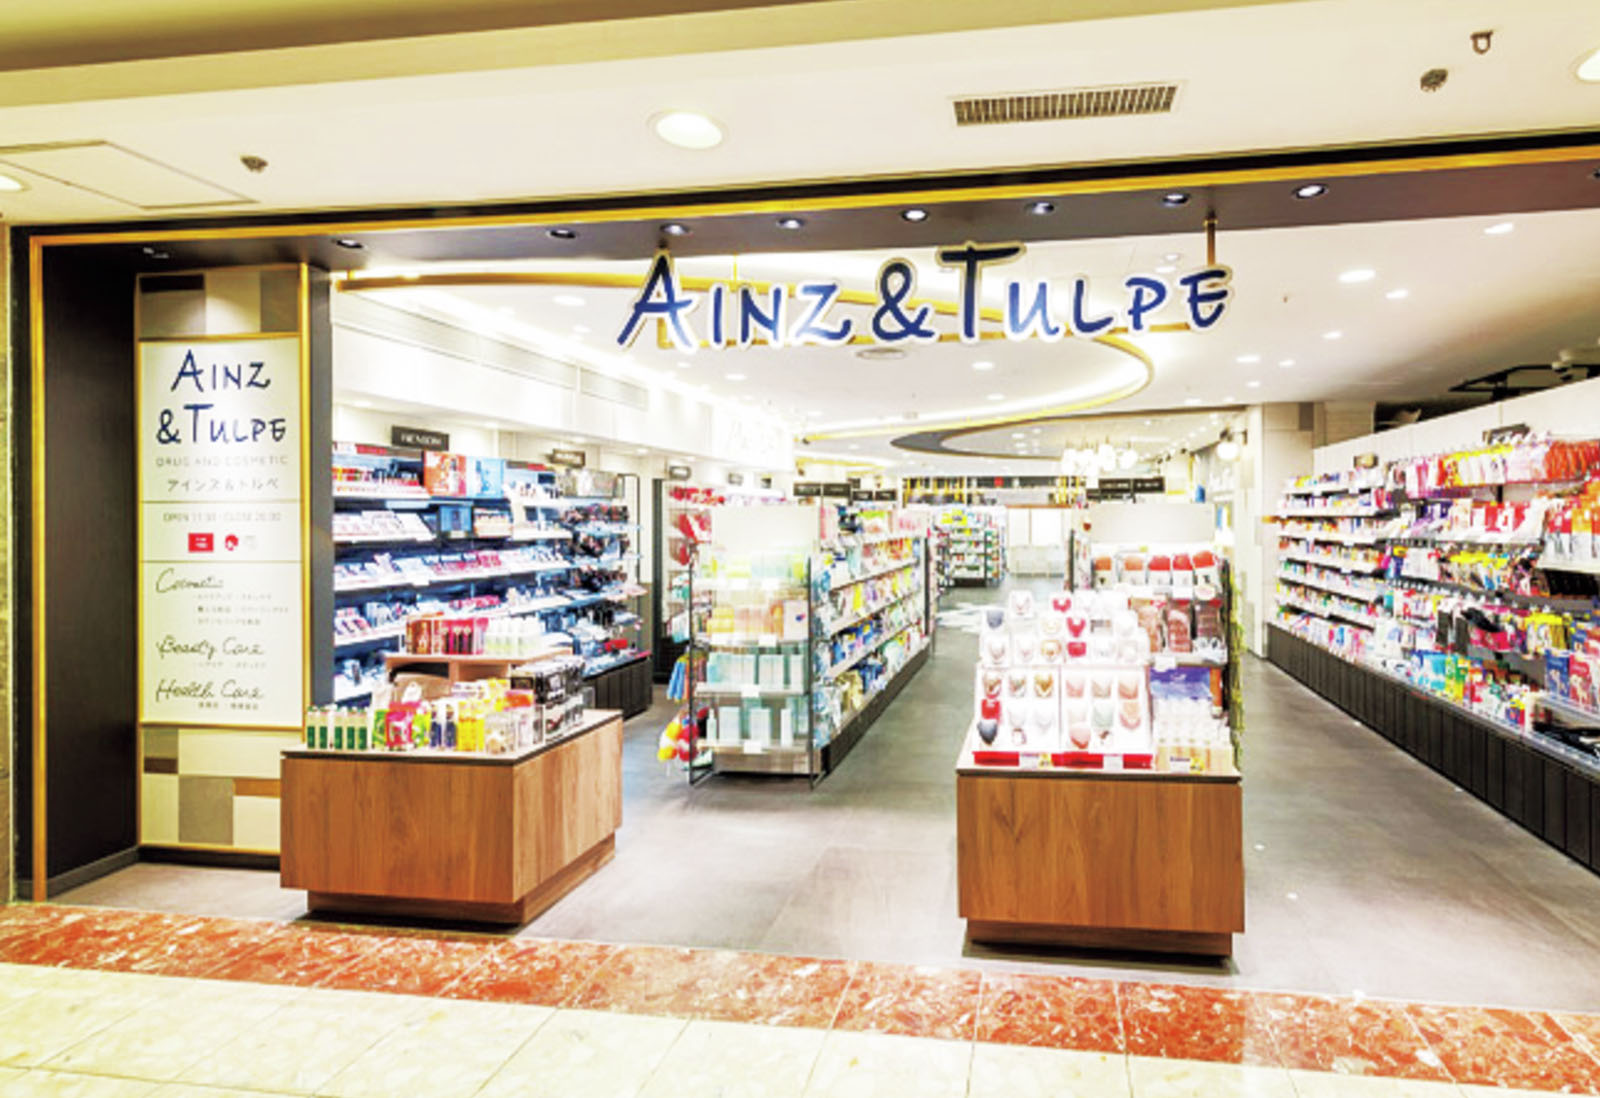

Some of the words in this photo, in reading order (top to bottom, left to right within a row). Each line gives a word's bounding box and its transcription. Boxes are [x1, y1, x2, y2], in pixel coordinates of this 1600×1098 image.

[618, 255, 852, 346] AINZ
[940, 246, 1229, 340] TULPE
[170, 349, 272, 393] AINZ
